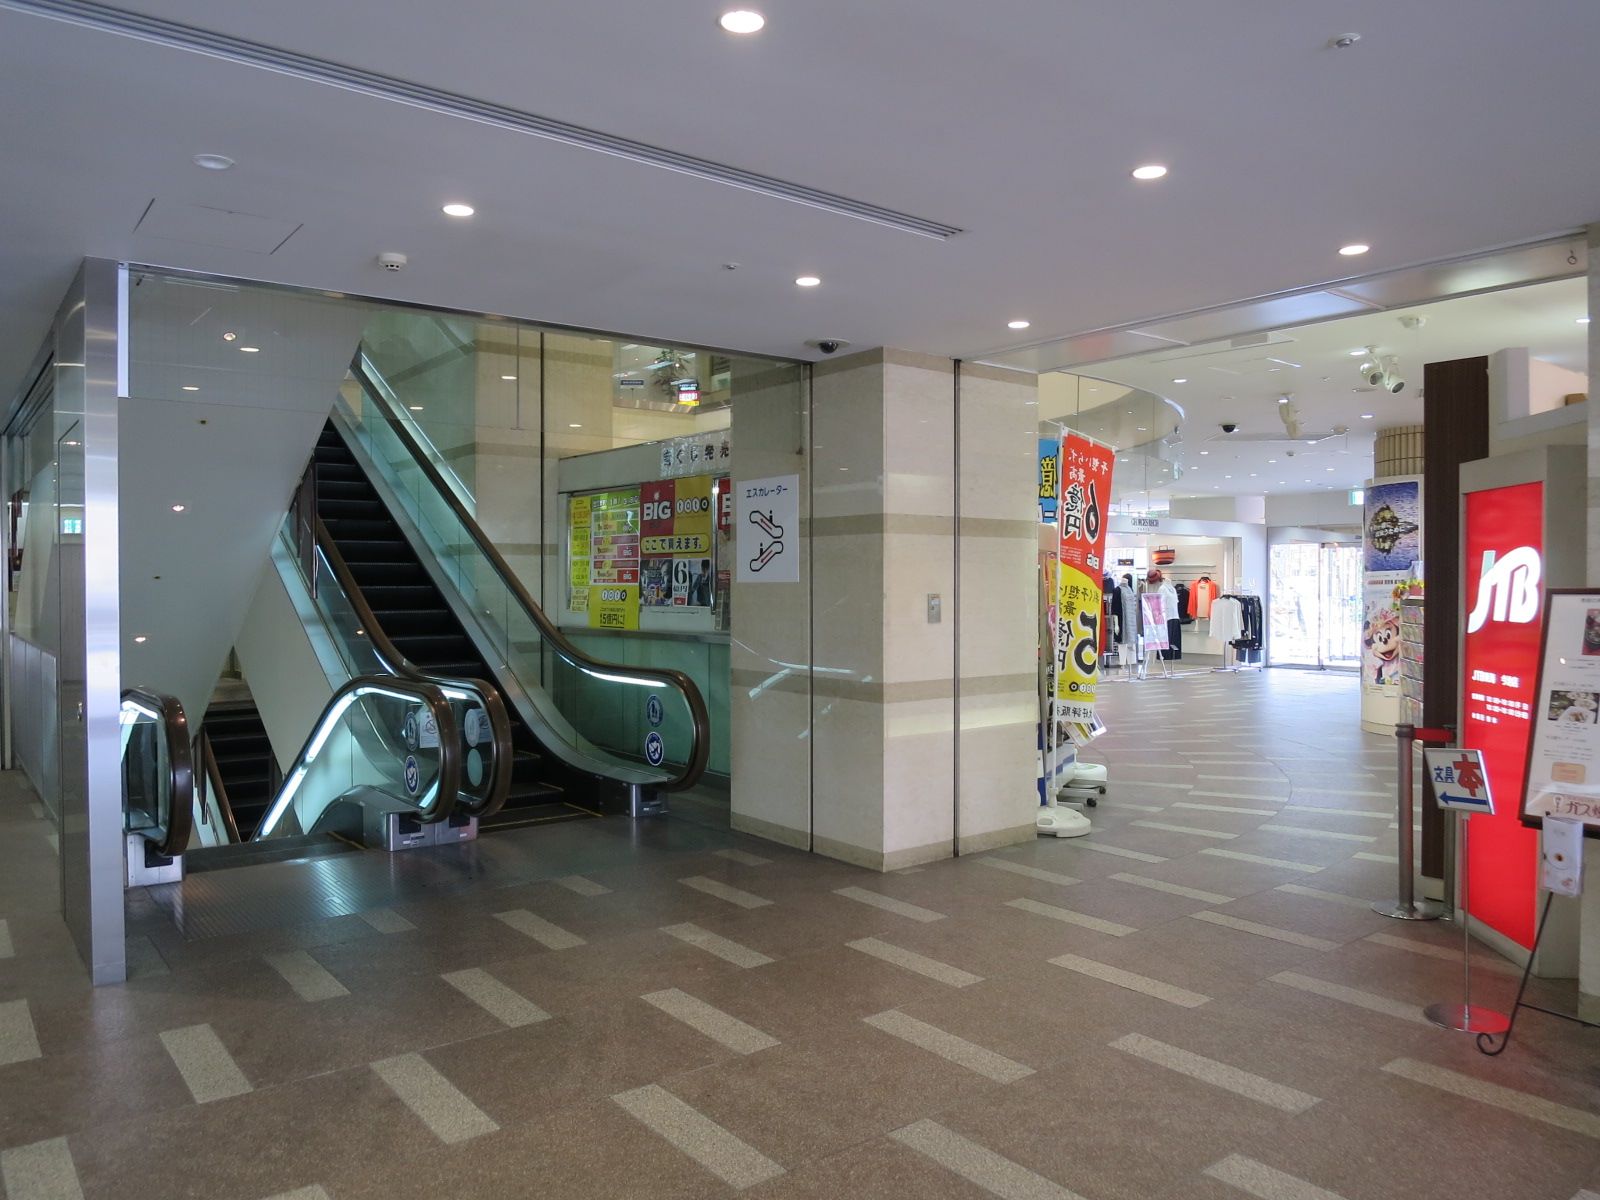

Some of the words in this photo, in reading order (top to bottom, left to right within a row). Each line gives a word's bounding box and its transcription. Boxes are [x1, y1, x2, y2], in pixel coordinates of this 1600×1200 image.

[746, 485, 788, 498] エスカレーター
[643, 501, 672, 520] BIG
[676, 496, 709, 512] toto
[1467, 546, 1541, 634] JTB
[1434, 765, 1455, 783] 文具
[1453, 753, 1484, 797] 本
